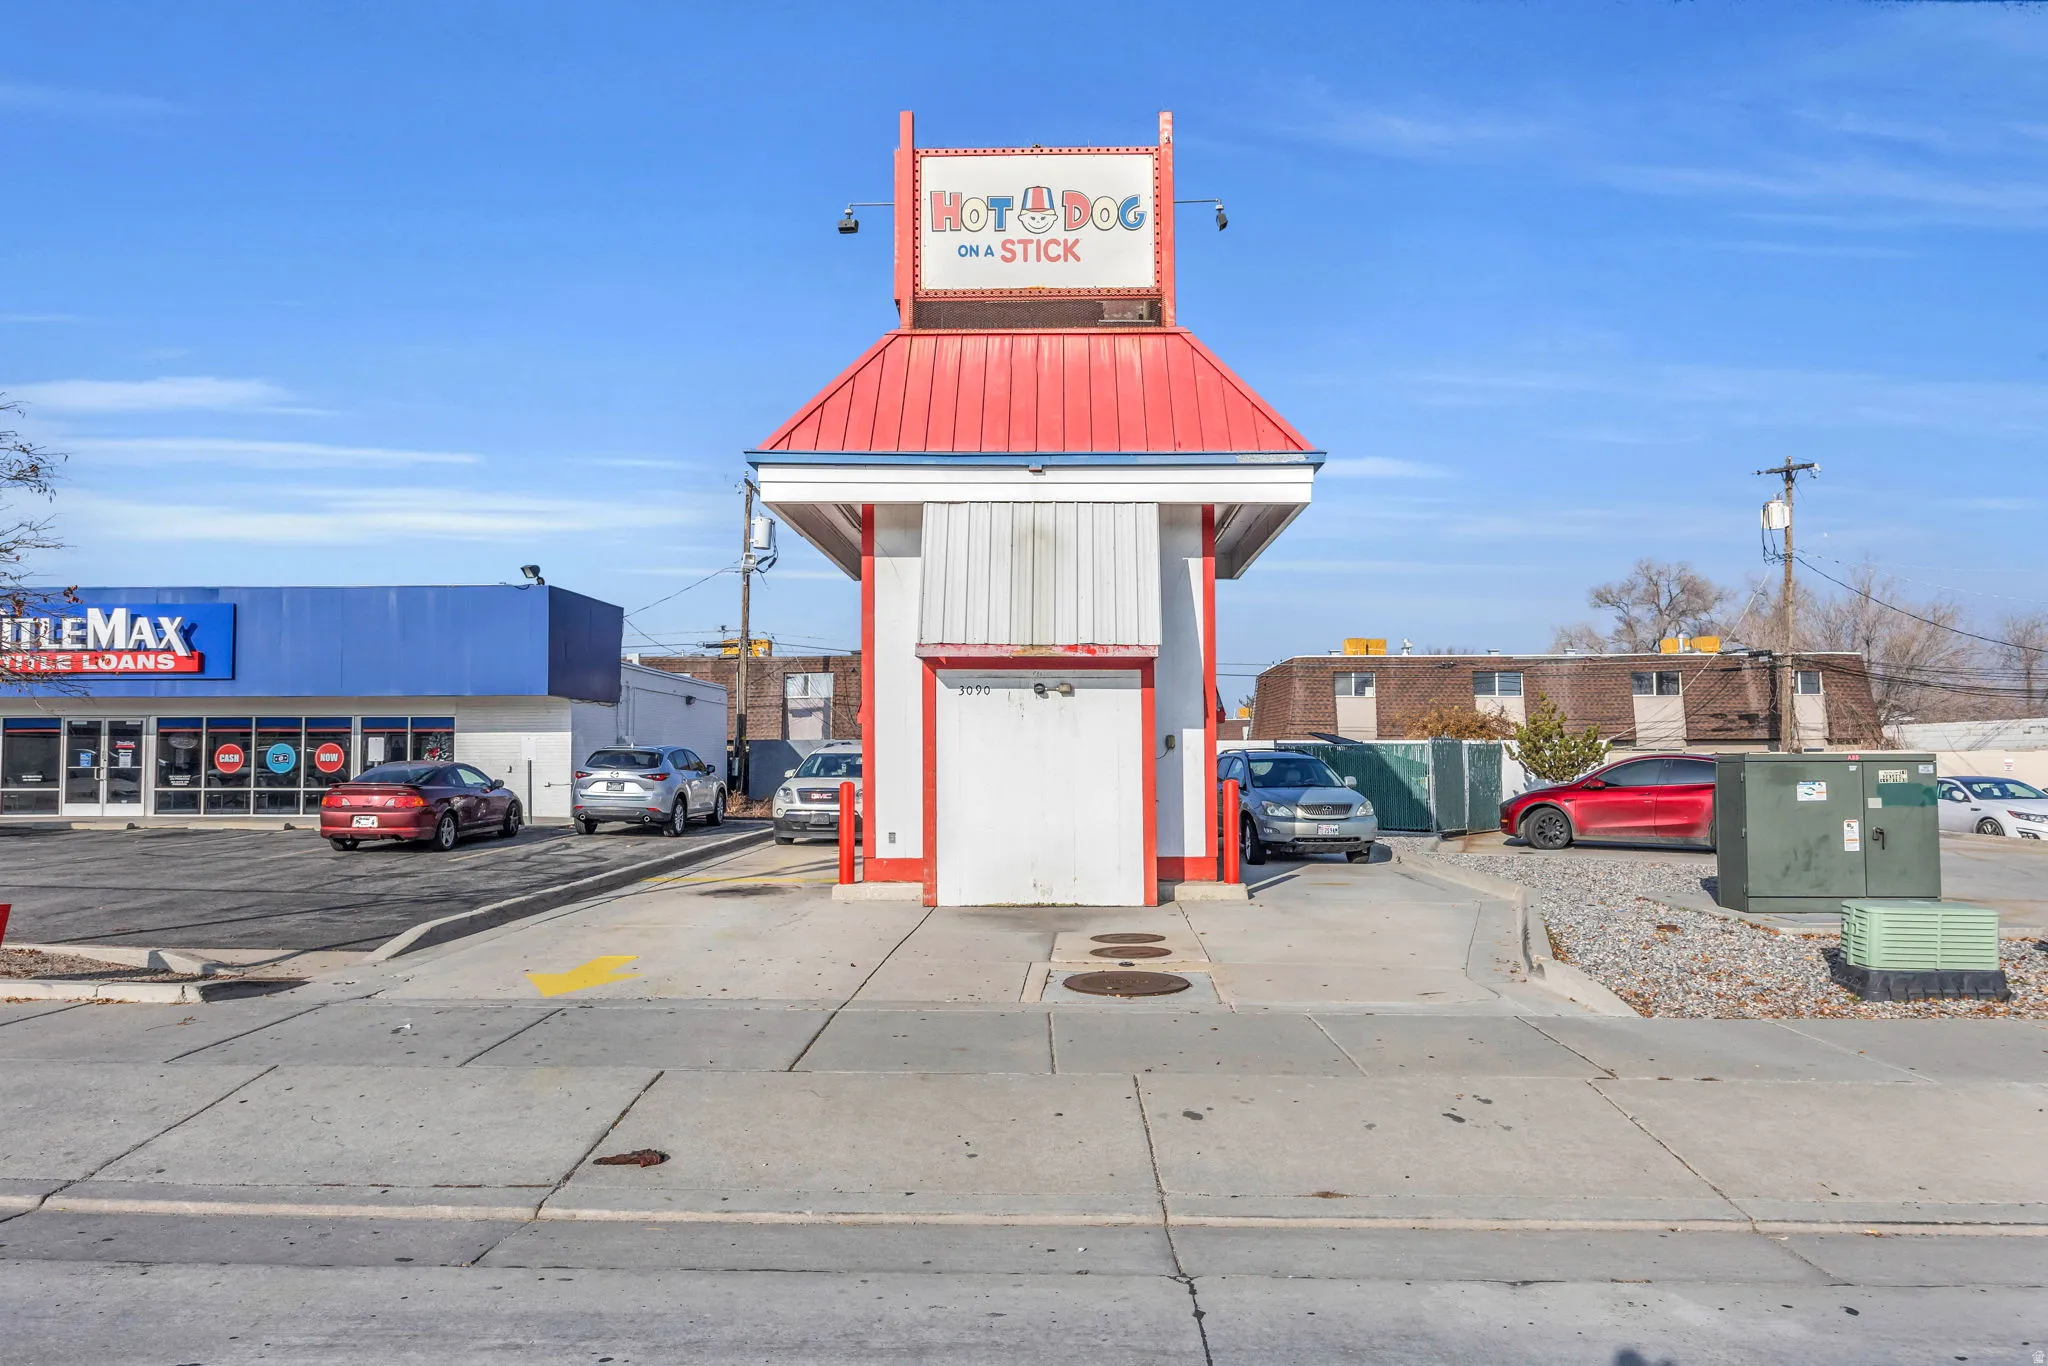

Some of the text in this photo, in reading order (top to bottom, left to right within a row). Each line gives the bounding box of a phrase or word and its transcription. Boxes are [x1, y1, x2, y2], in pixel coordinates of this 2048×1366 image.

[930, 190, 1147, 232] HOT DOG
[958, 238, 1082, 263] ON A STICK
[0, 654, 175, 670] TITLE LOANS
[958, 685, 991, 696] 3090
[219, 754, 240, 763] CASH
[320, 753, 339, 762] NOW
